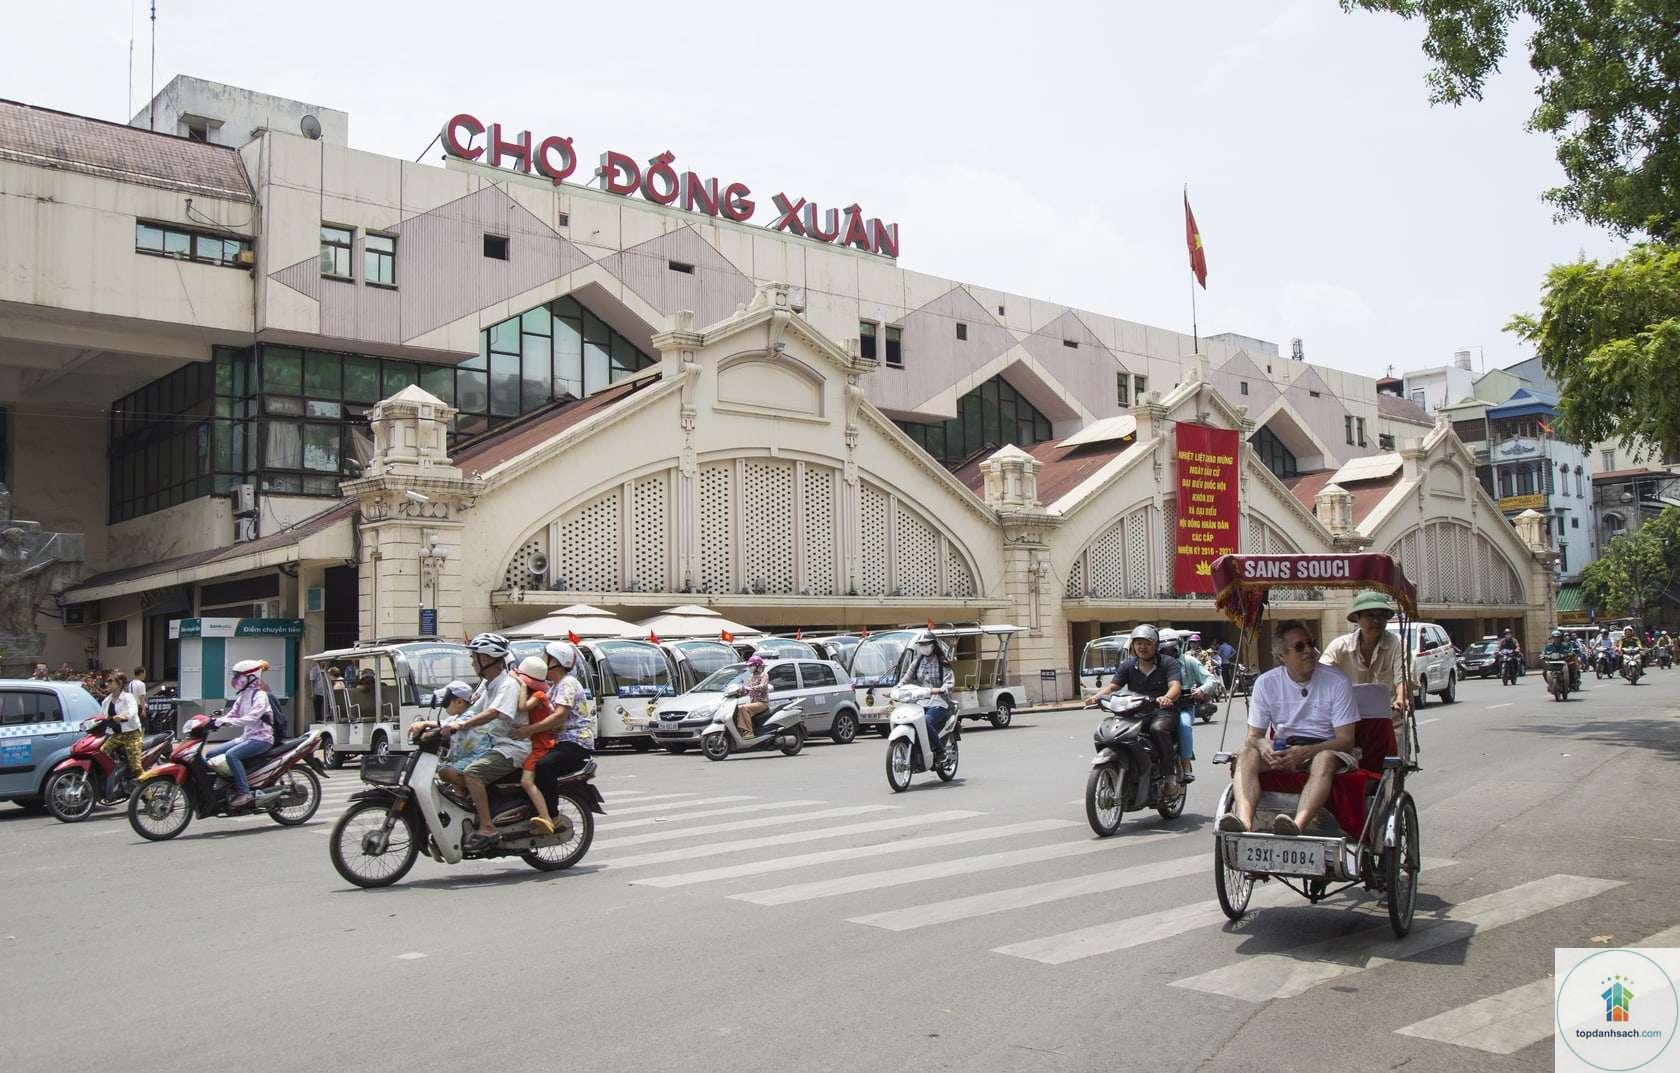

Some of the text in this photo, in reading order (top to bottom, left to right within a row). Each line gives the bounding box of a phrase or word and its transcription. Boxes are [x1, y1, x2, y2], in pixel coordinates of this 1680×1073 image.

[440, 113, 577, 186] CHỢ
[771, 191, 899, 258] XUÂN
[1244, 559, 1350, 579] SANS SOUCI
